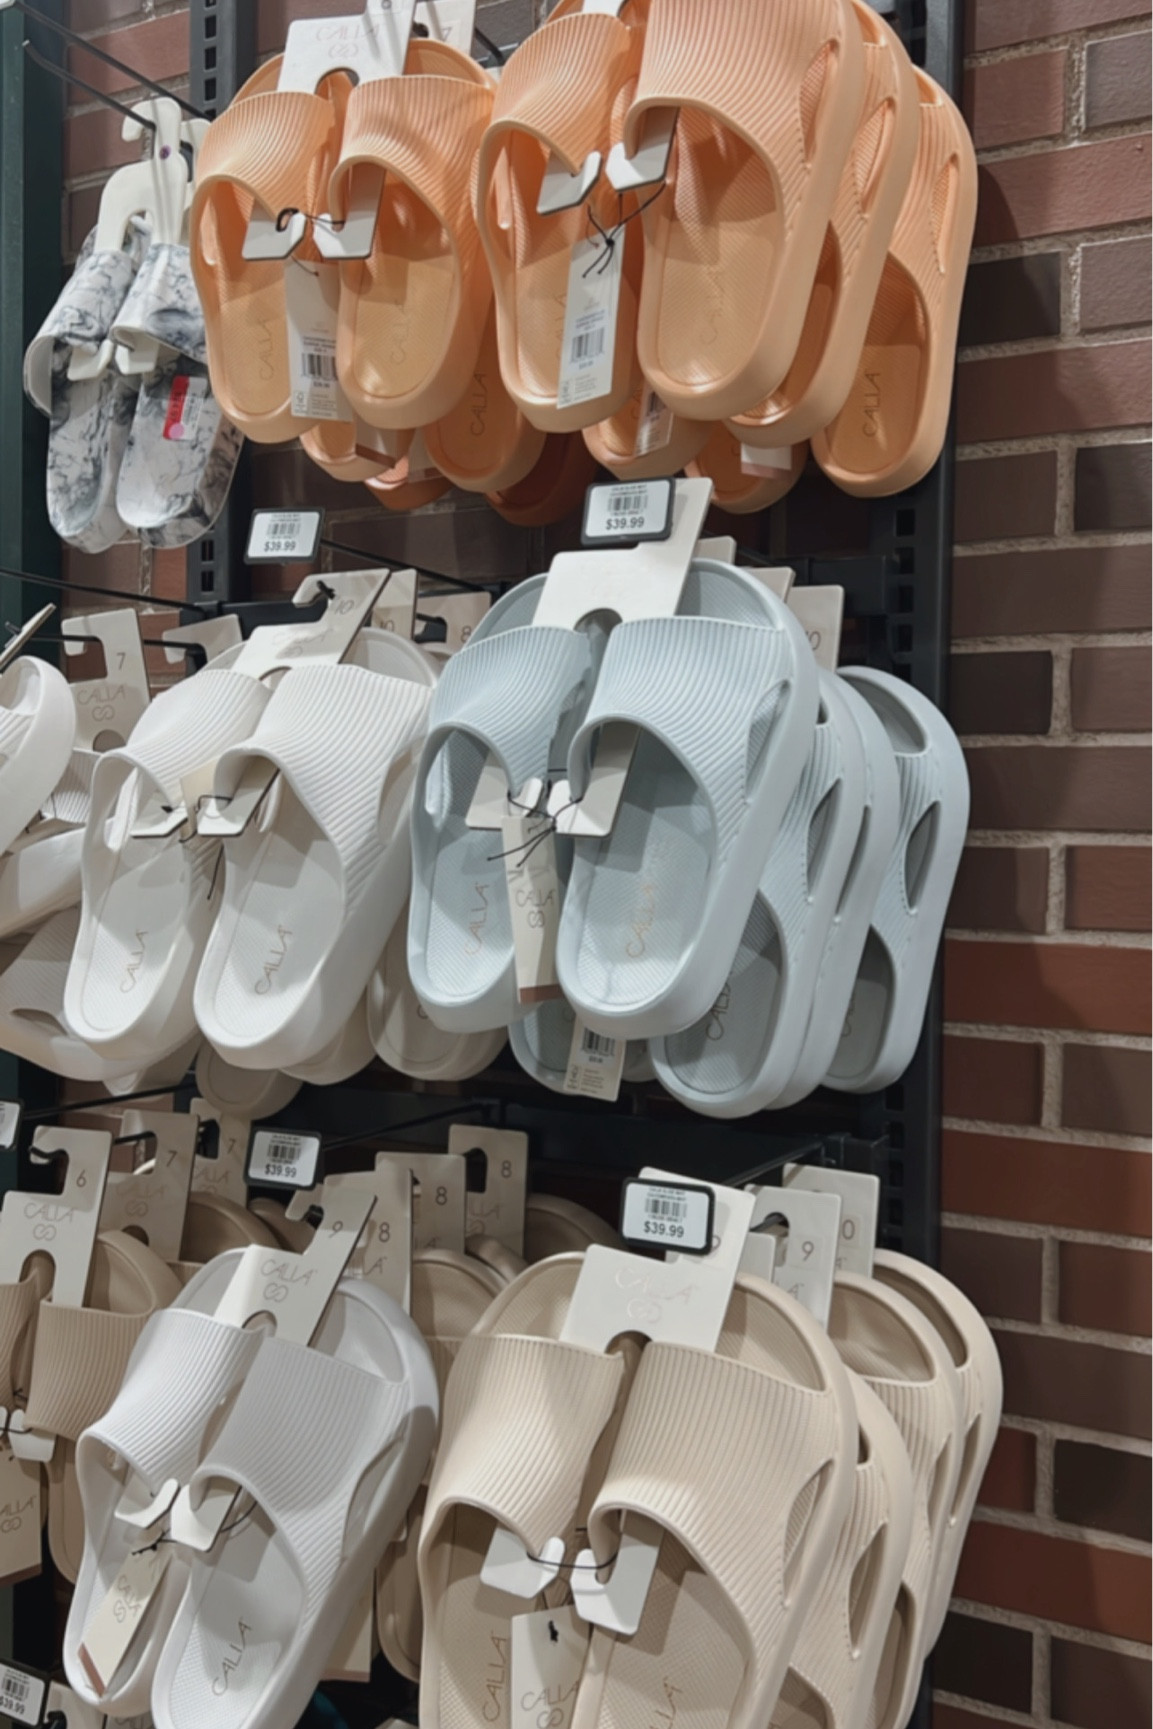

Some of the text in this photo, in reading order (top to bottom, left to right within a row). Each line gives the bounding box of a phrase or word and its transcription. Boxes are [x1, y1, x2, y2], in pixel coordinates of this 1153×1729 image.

[606, 516, 646, 531] $39.99
[263, 540, 297, 553] $39.99
[334, 599, 355, 615] 10
[116, 652, 126, 670] 7
[228, 1137, 237, 1154] 7
[163, 1151, 178, 1167] 7
[264, 1162, 298, 1179] $39.99
[501, 1160, 512, 1179] 8
[76, 1170, 88, 1188] 6
[435, 1185, 447, 1206] 8
[328, 1220, 344, 1239] 9
[378, 1221, 390, 1243] 8
[643, 1220, 686, 1239] $39.99
[801, 1240, 815, 1262] 9
[0, 1495, 37, 1517] ALIA
